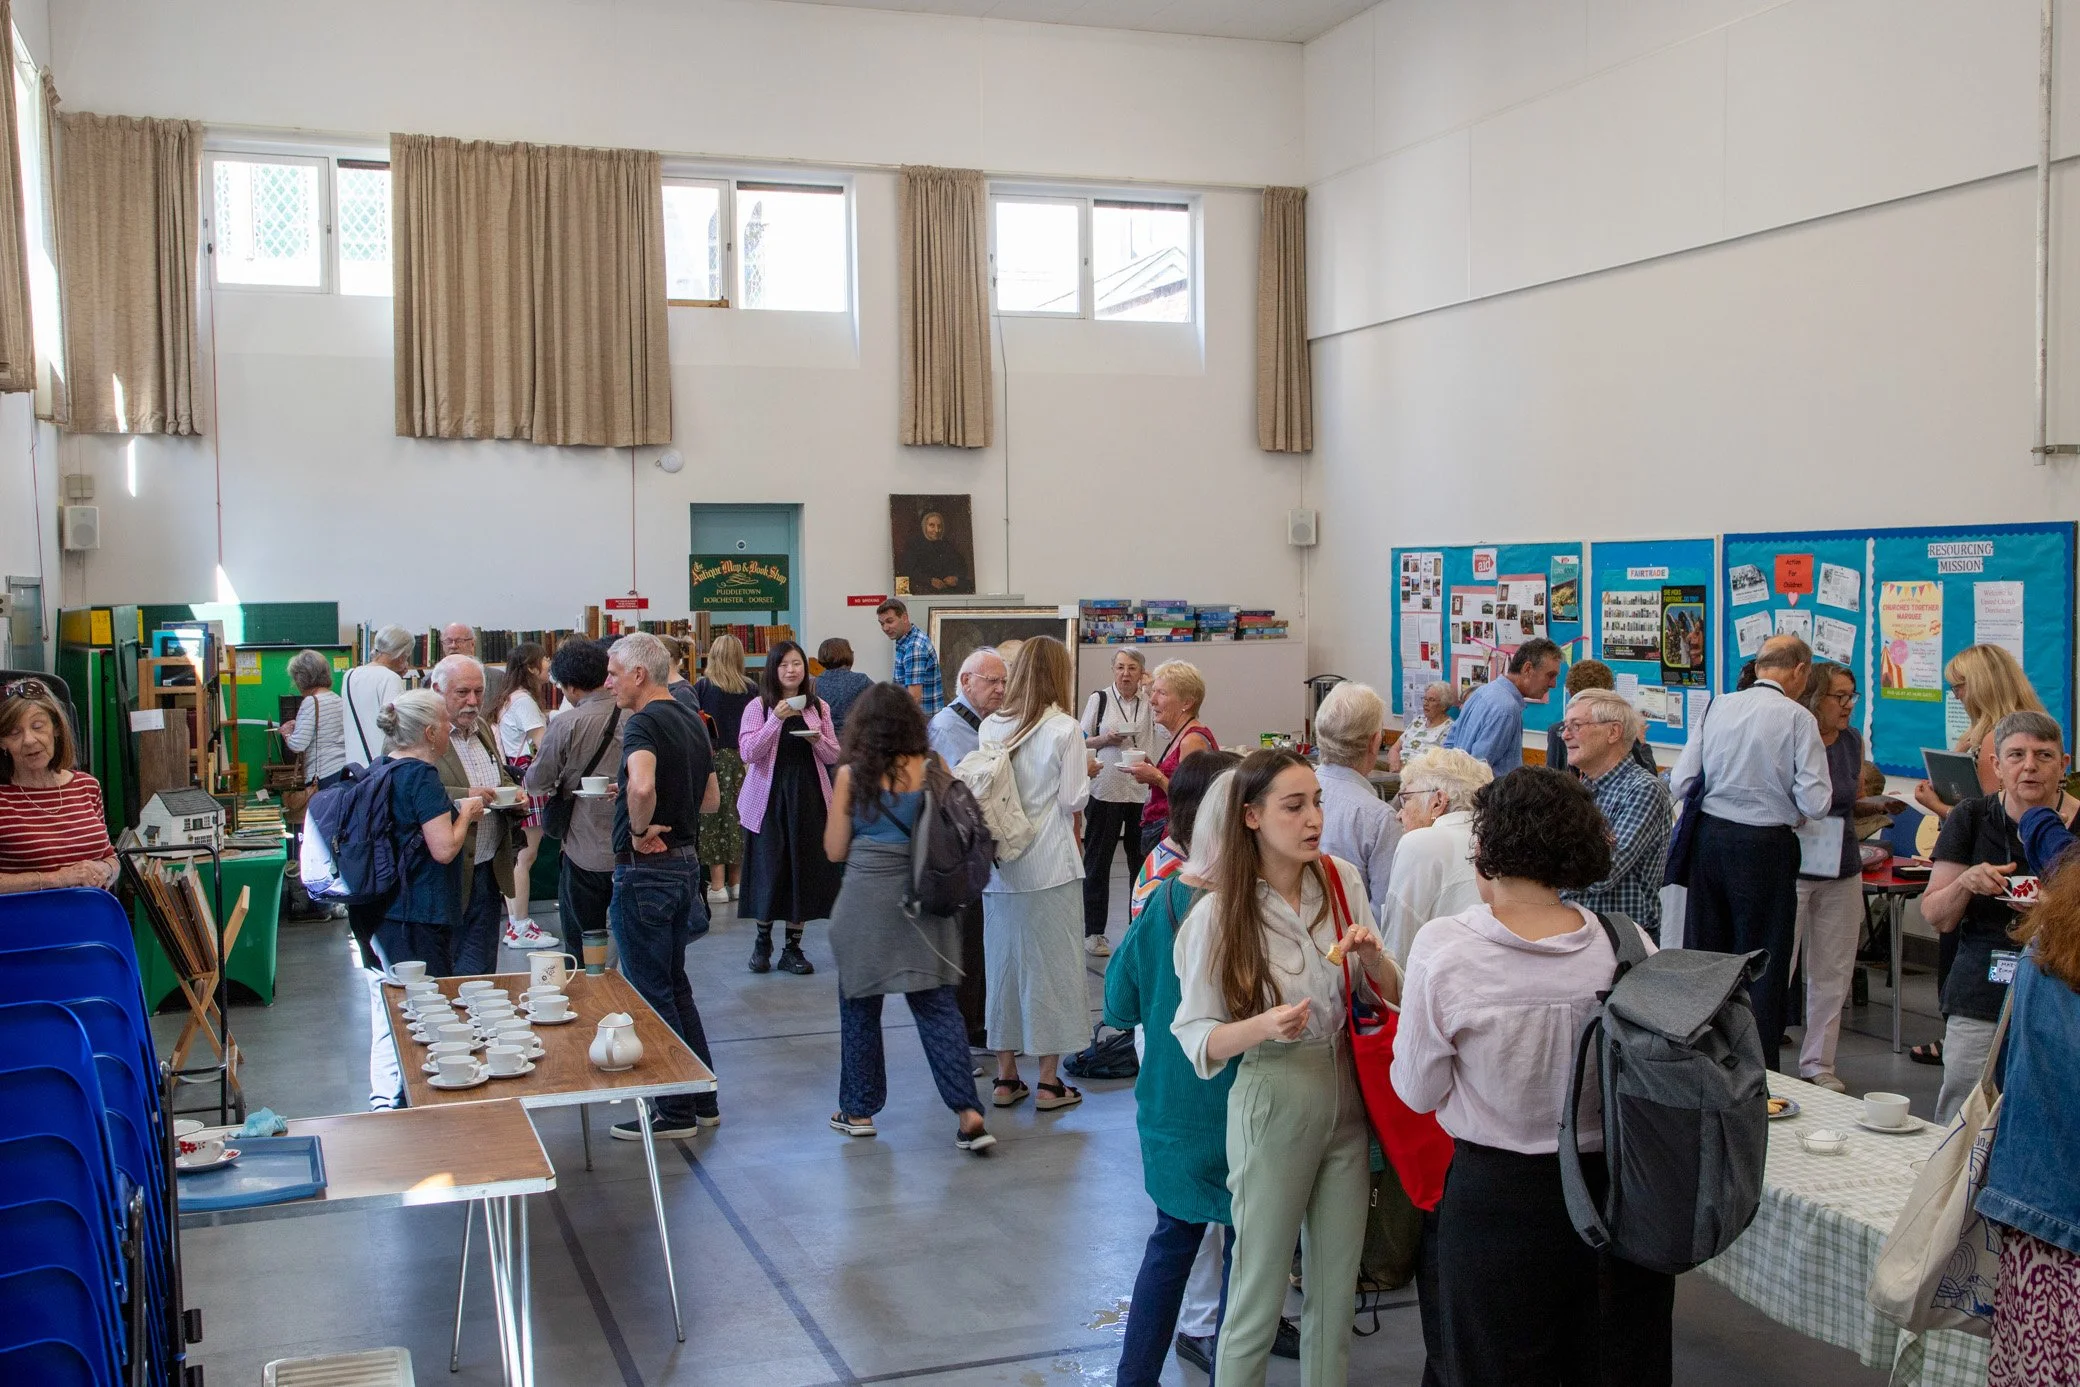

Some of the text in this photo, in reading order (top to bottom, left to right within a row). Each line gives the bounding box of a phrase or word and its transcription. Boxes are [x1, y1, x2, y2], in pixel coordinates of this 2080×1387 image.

[1930, 543, 1991, 556] RESOURCING
[1477, 557, 1490, 571] aid
[1940, 560, 1981, 572] MISSION
[691, 560, 787, 586] Antique Map & Book Shop
[1630, 568, 1666, 578] FAIRTRADE
[716, 588, 761, 596] PUDDLETOWN
